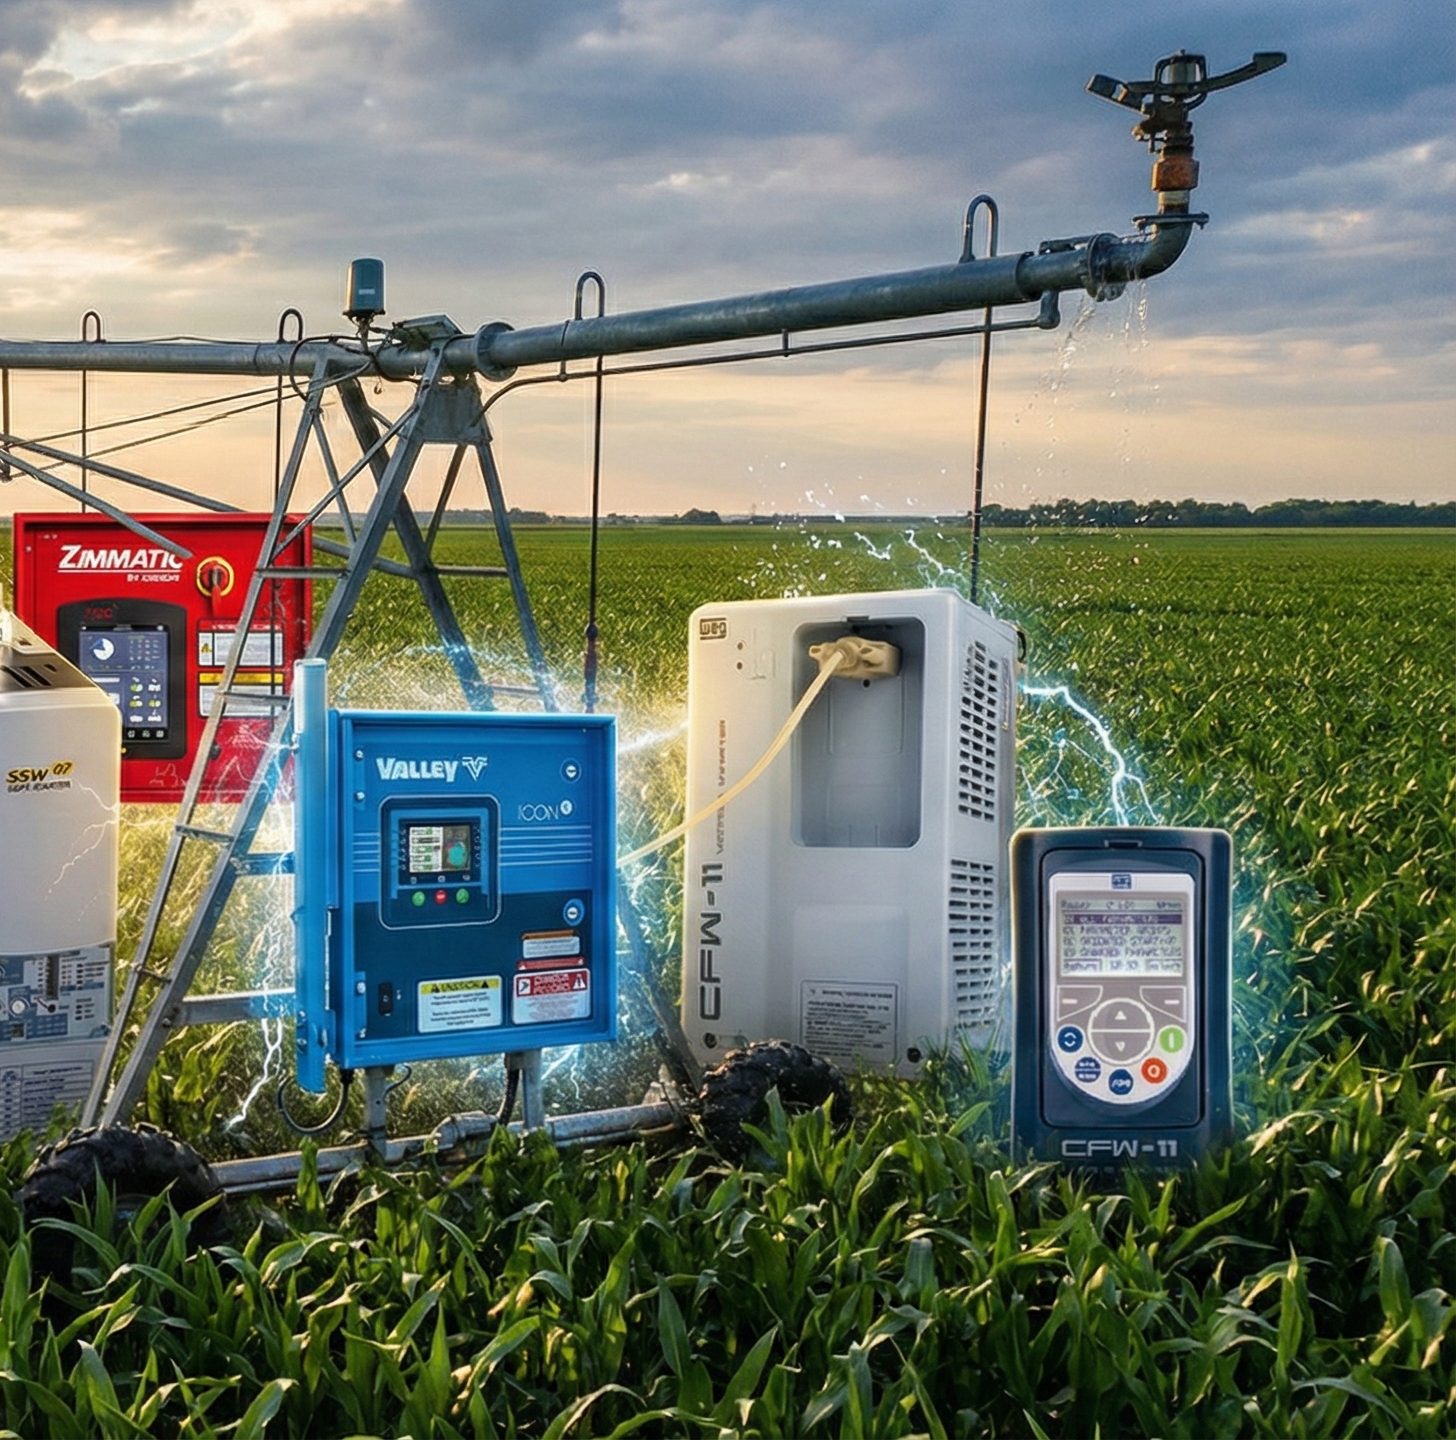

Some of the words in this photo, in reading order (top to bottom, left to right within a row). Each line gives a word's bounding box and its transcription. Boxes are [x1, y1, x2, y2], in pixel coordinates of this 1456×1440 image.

[58, 545, 183, 569] ZIMMATIC
[6, 769, 49, 783] SSW
[52, 762, 73, 775] 07
[700, 863, 723, 1020] CFW-11
[1062, 1139, 1178, 1157] CFW-11
